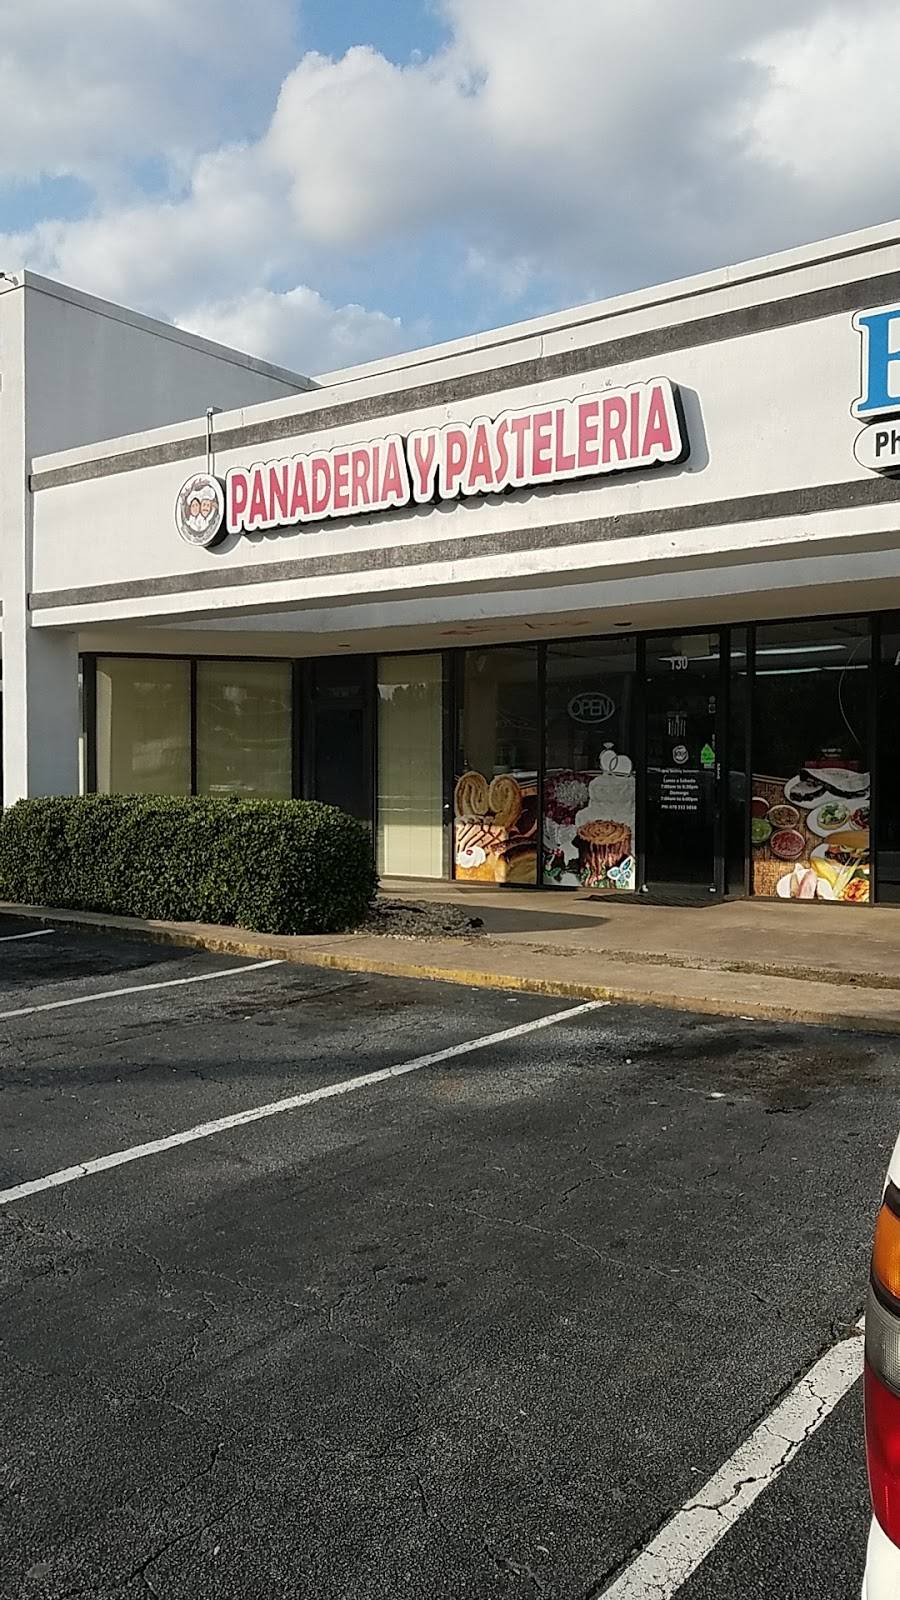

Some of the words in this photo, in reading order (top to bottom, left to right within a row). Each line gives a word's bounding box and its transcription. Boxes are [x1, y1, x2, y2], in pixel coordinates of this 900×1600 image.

[231, 442, 404, 527] PANADERIA
[414, 434, 436, 495] Y
[445, 385, 673, 491] PASTELERIA
[569, 699, 611, 716] OPEN
